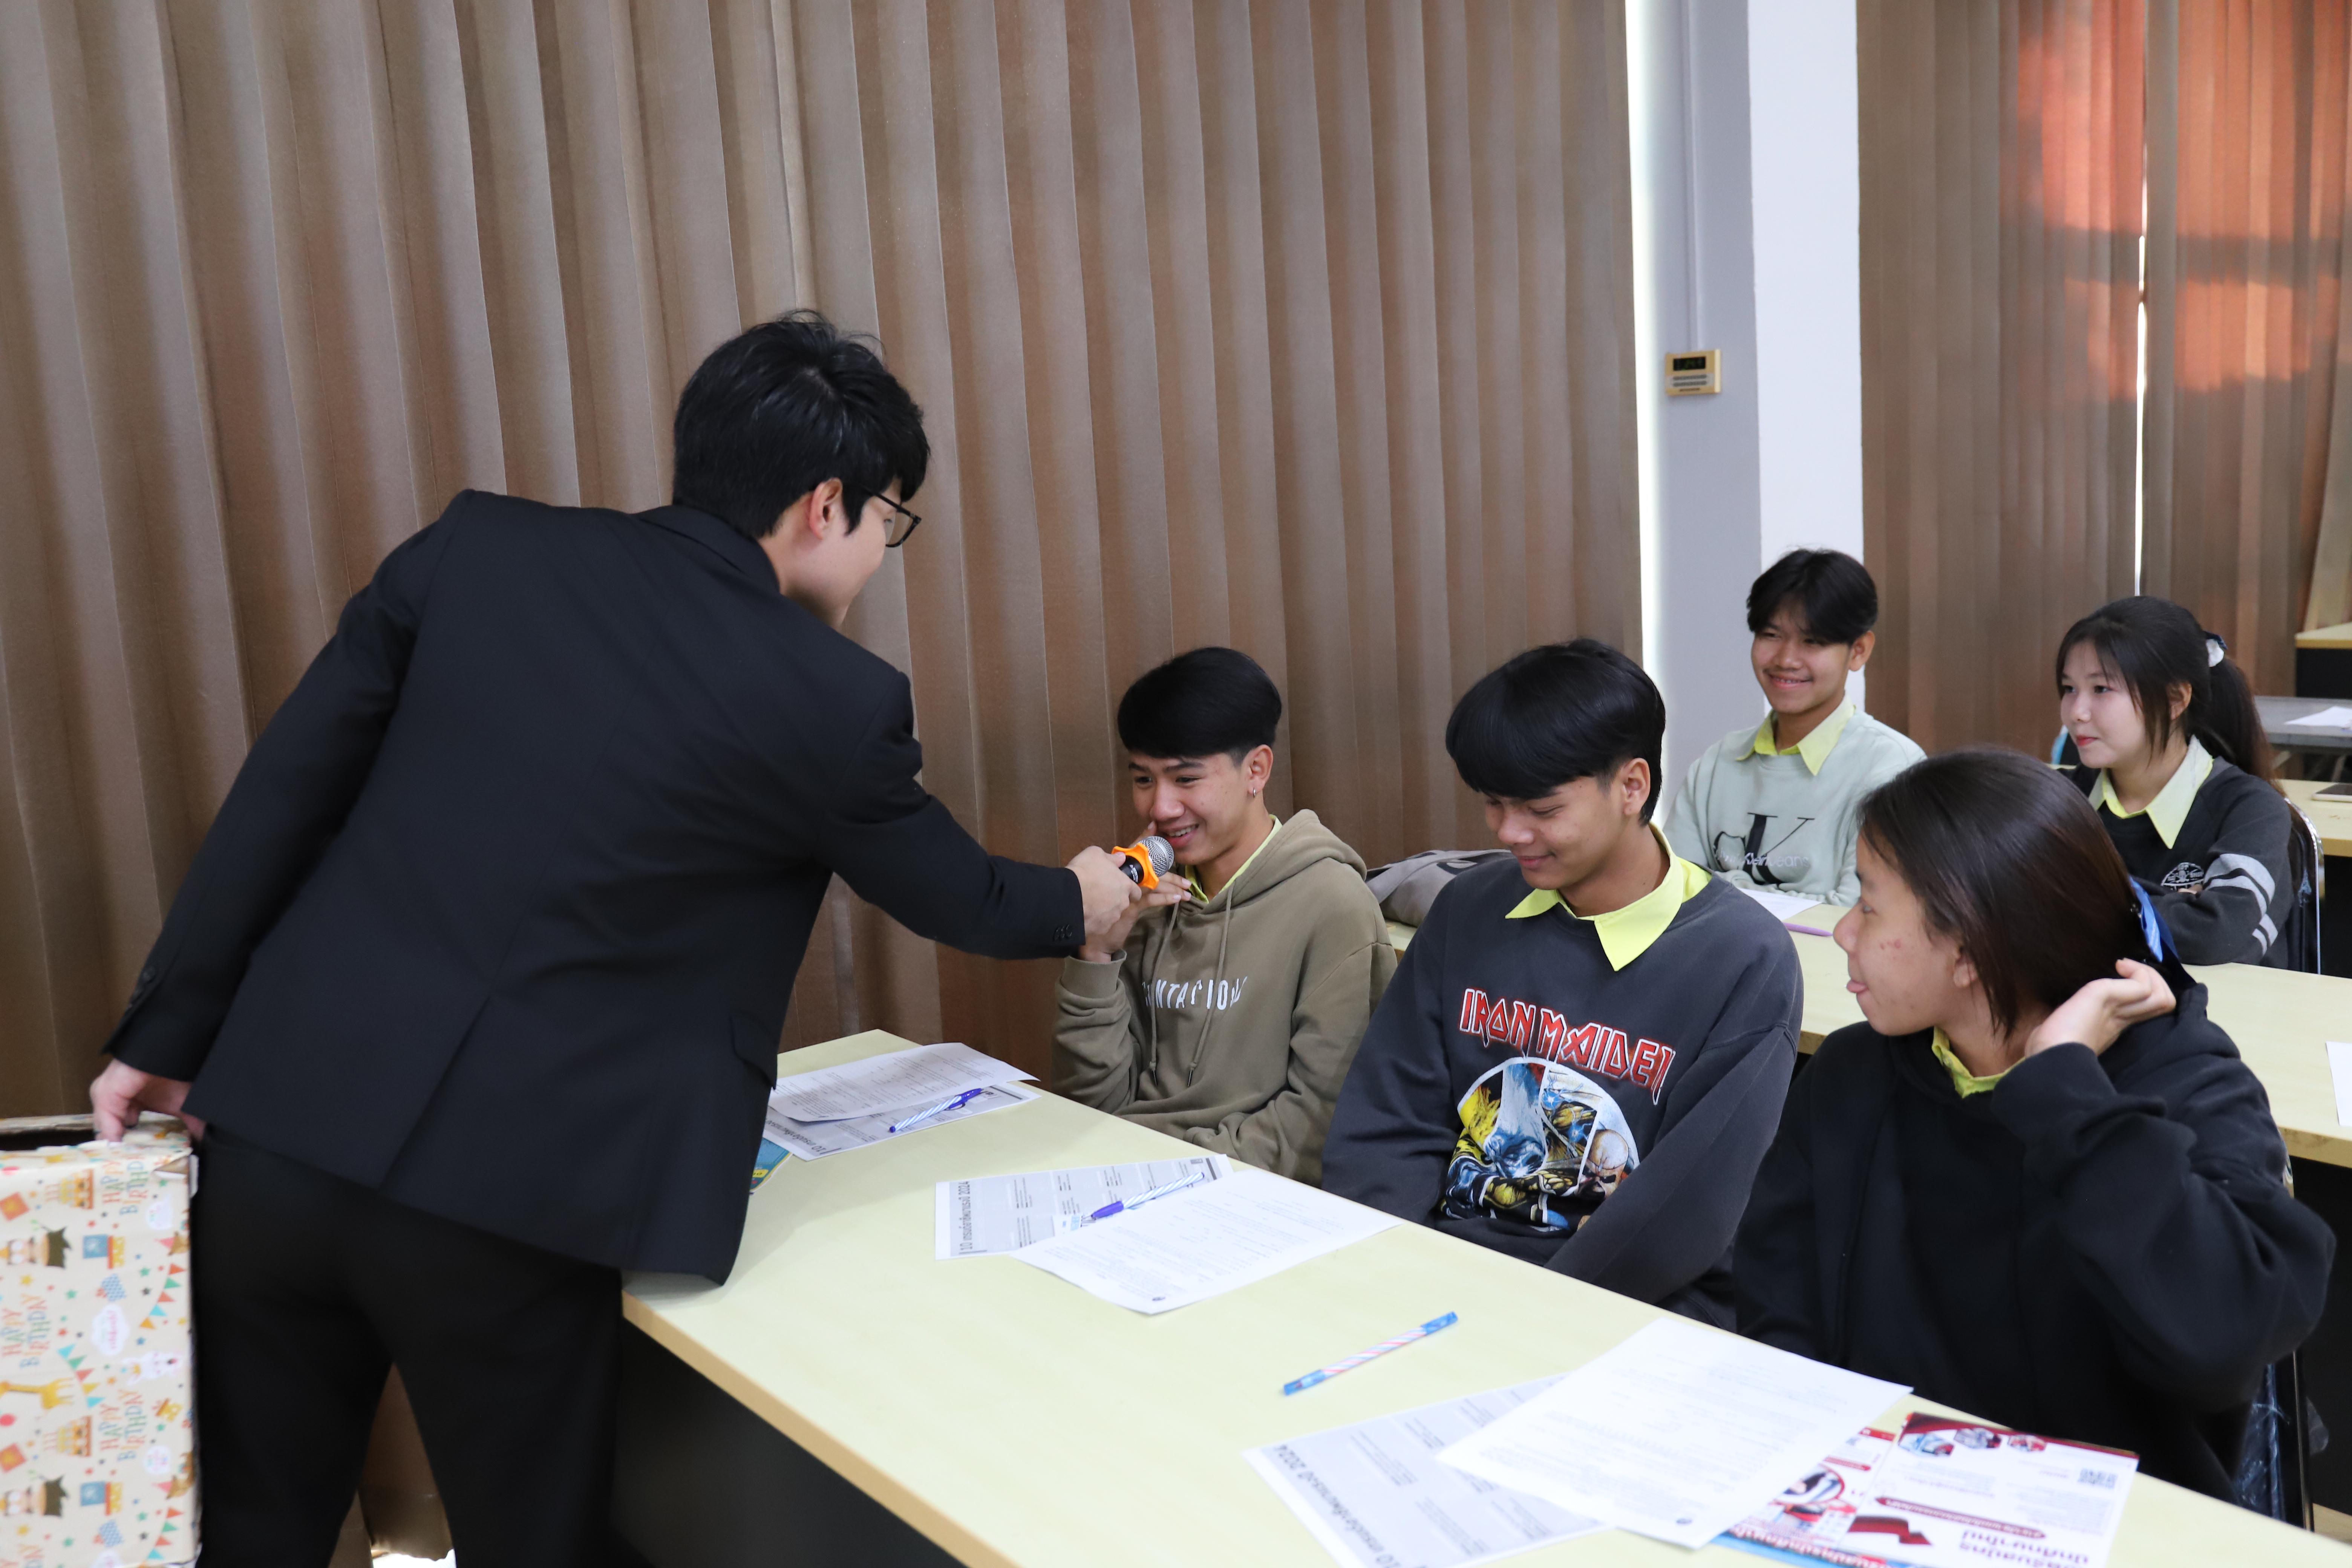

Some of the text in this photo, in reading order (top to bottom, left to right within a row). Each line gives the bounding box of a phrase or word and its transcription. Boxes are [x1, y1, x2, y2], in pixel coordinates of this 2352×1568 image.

[1459, 988, 1536, 1058] IRON
[100, 1160, 124, 1204] HAPPY
[958, 1181, 970, 1195] 2024
[1, 1308, 25, 1356] HAPPY
[20, 1294, 51, 1367] BIRTHDAY
[98, 1403, 123, 1450] HAPPY
[117, 1389, 147, 1461] BIRTHDAY
[1273, 1444, 1306, 1469] 2024
